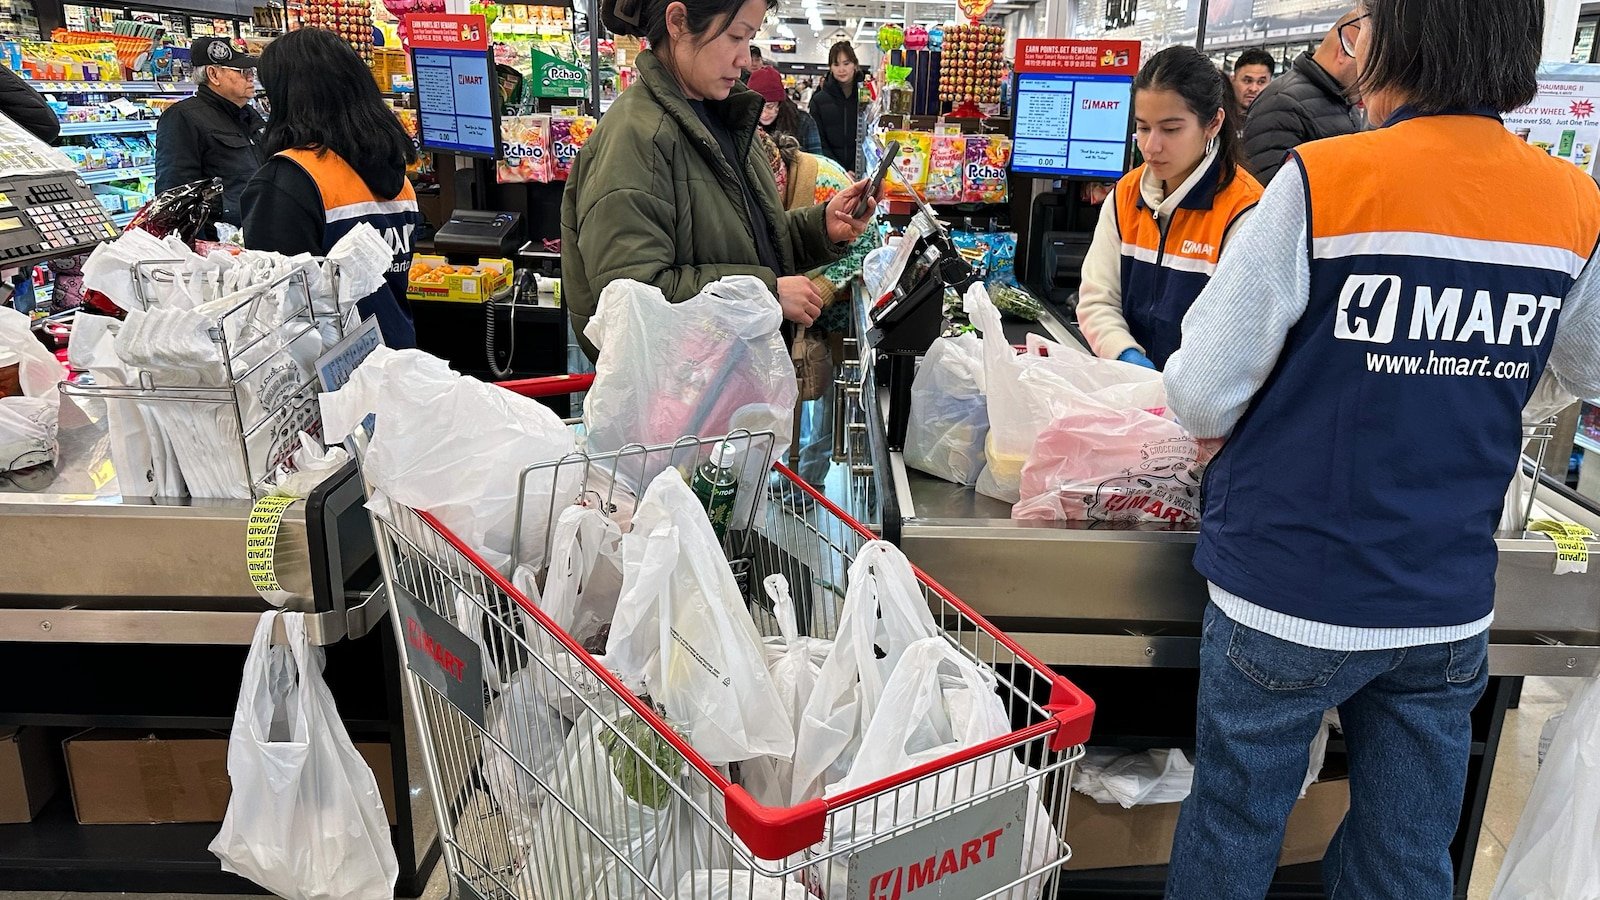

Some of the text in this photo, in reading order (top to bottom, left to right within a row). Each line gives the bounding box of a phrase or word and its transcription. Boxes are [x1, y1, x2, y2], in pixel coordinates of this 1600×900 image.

[1025, 45, 1039, 53] EARN
[1071, 46, 1098, 54] REWARDS!
[465, 76, 483, 85] MART
[1537, 84, 1577, 92] CHAUMBURG
[1092, 101, 1120, 110] MART
[1408, 285, 1562, 346] MART
[1366, 350, 1530, 379] www.hmart.com
[1149, 445, 1187, 456] GROCERIES
[249, 527, 268, 535] PAID
[1559, 553, 1578, 561] PAID
[421, 630, 465, 683] MART
[907, 828, 1004, 893] MART
